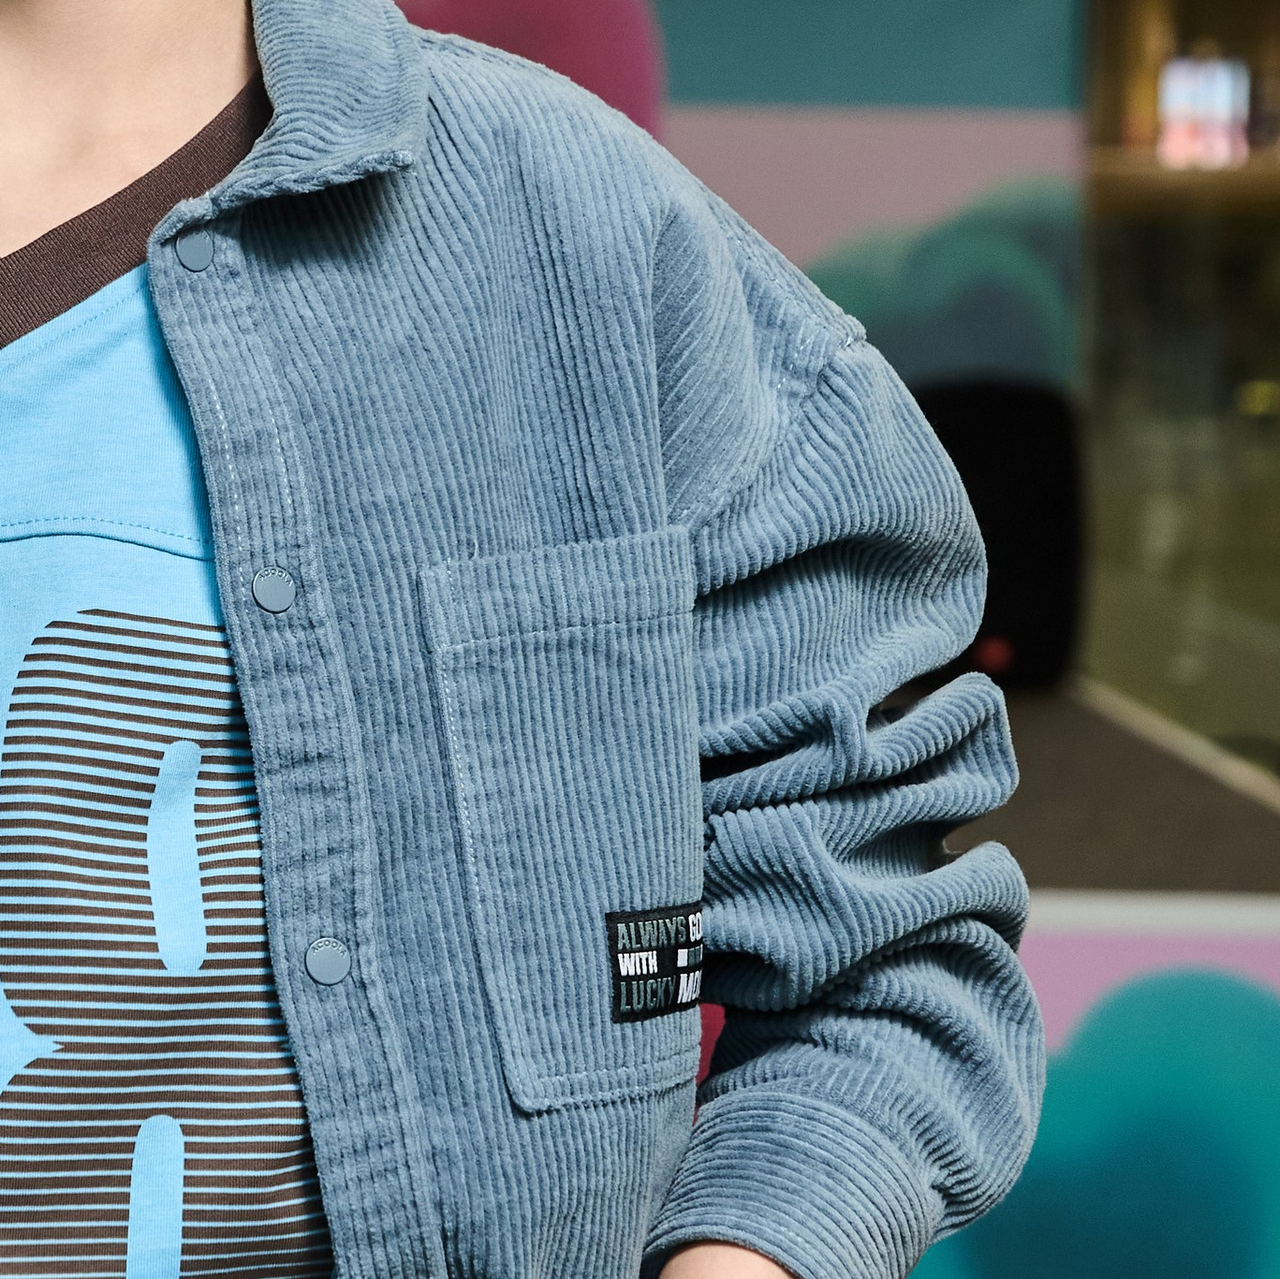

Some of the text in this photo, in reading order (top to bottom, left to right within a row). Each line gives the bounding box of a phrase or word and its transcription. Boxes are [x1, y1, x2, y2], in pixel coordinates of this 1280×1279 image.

[617, 911, 703, 950] ALWAYS GO
[617, 950, 658, 977] WITH
[620, 968, 703, 1013] LUCKY MO
